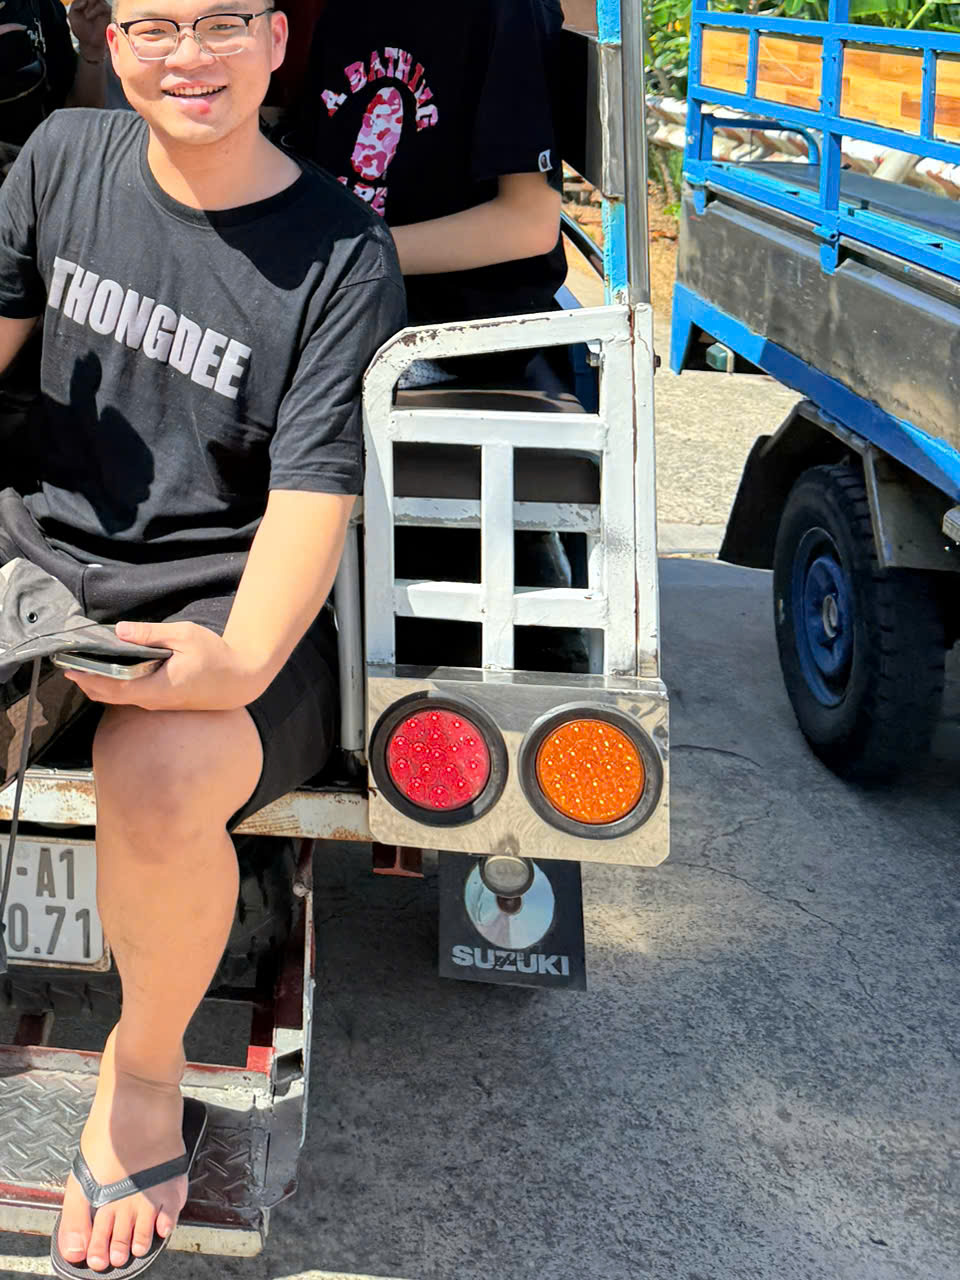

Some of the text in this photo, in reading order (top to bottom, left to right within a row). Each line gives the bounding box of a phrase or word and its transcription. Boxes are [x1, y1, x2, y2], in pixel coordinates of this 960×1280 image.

[321, 47, 438, 132] A BATHING
[47, 256, 252, 399] THONGDEE
[451, 945, 570, 977] SUZUKI
